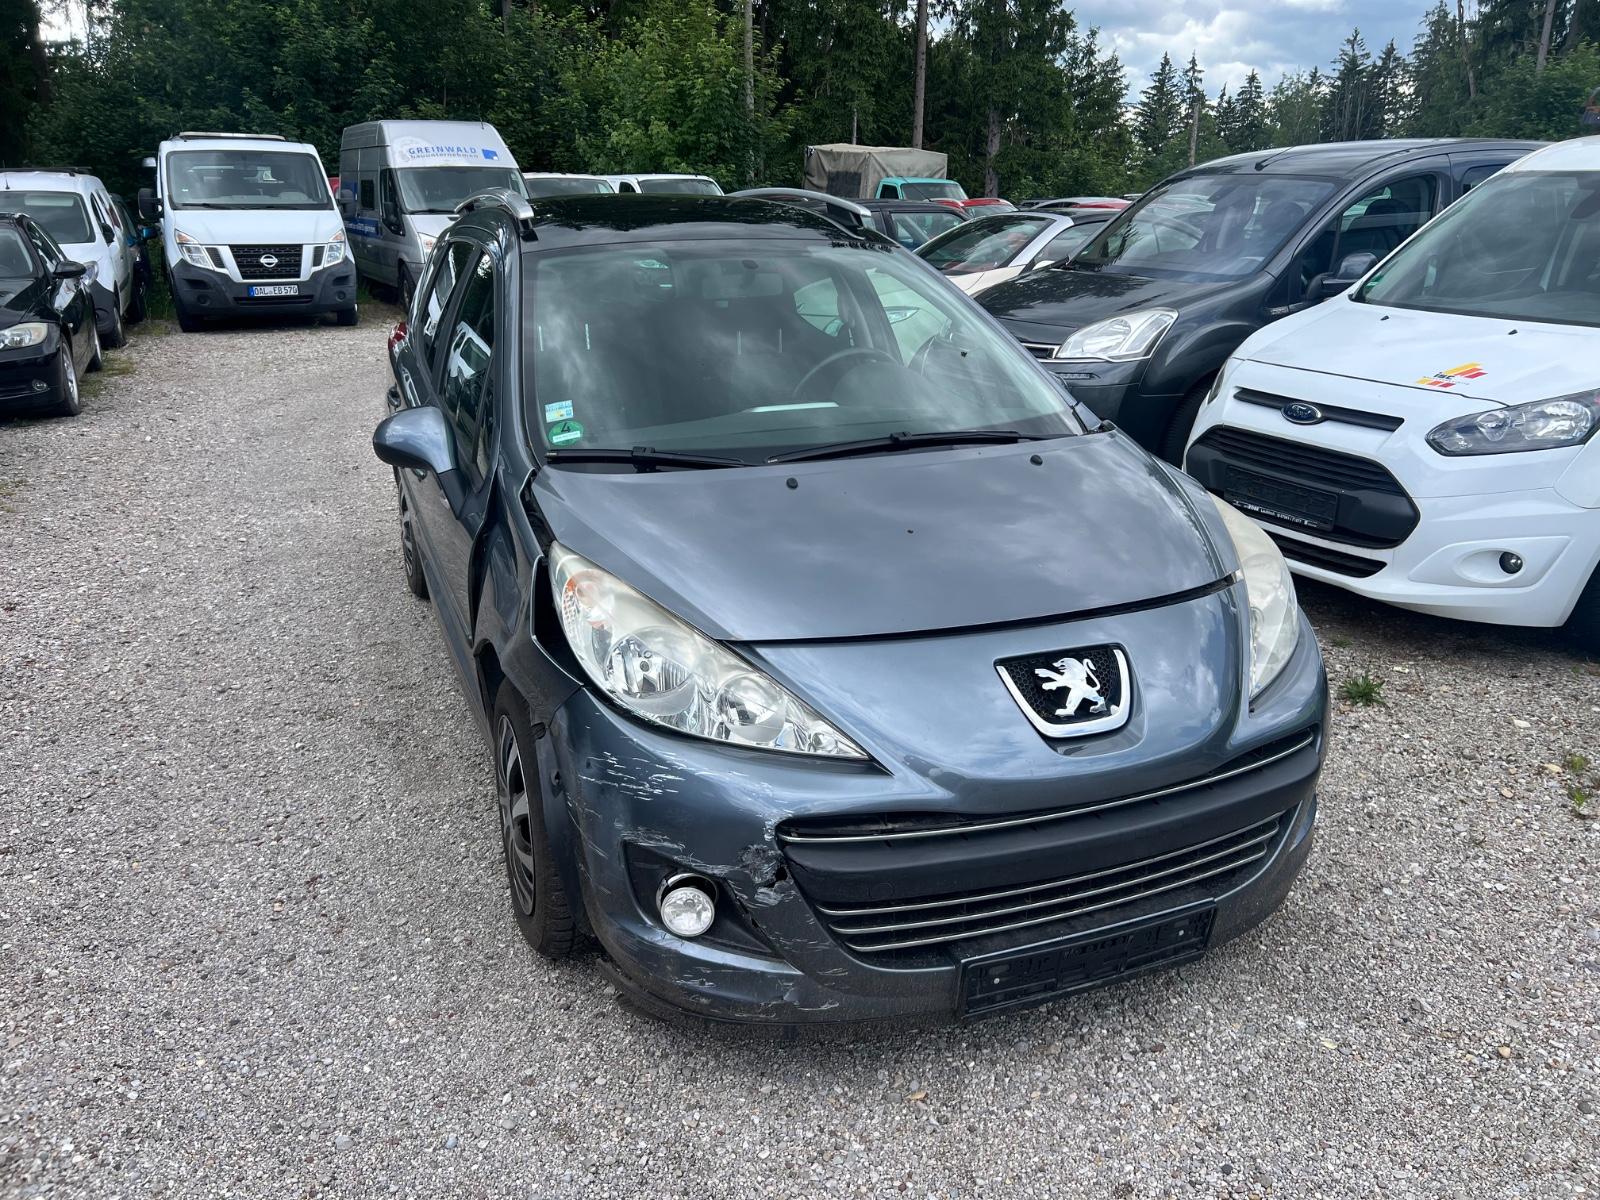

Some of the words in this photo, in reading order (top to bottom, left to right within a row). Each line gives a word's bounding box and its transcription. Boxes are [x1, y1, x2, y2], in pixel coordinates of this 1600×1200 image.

[408, 145, 477, 155] GREINWALD
[273, 286, 283, 295] EB
[283, 286, 298, 294] 570
[560, 422, 571, 432] 4
